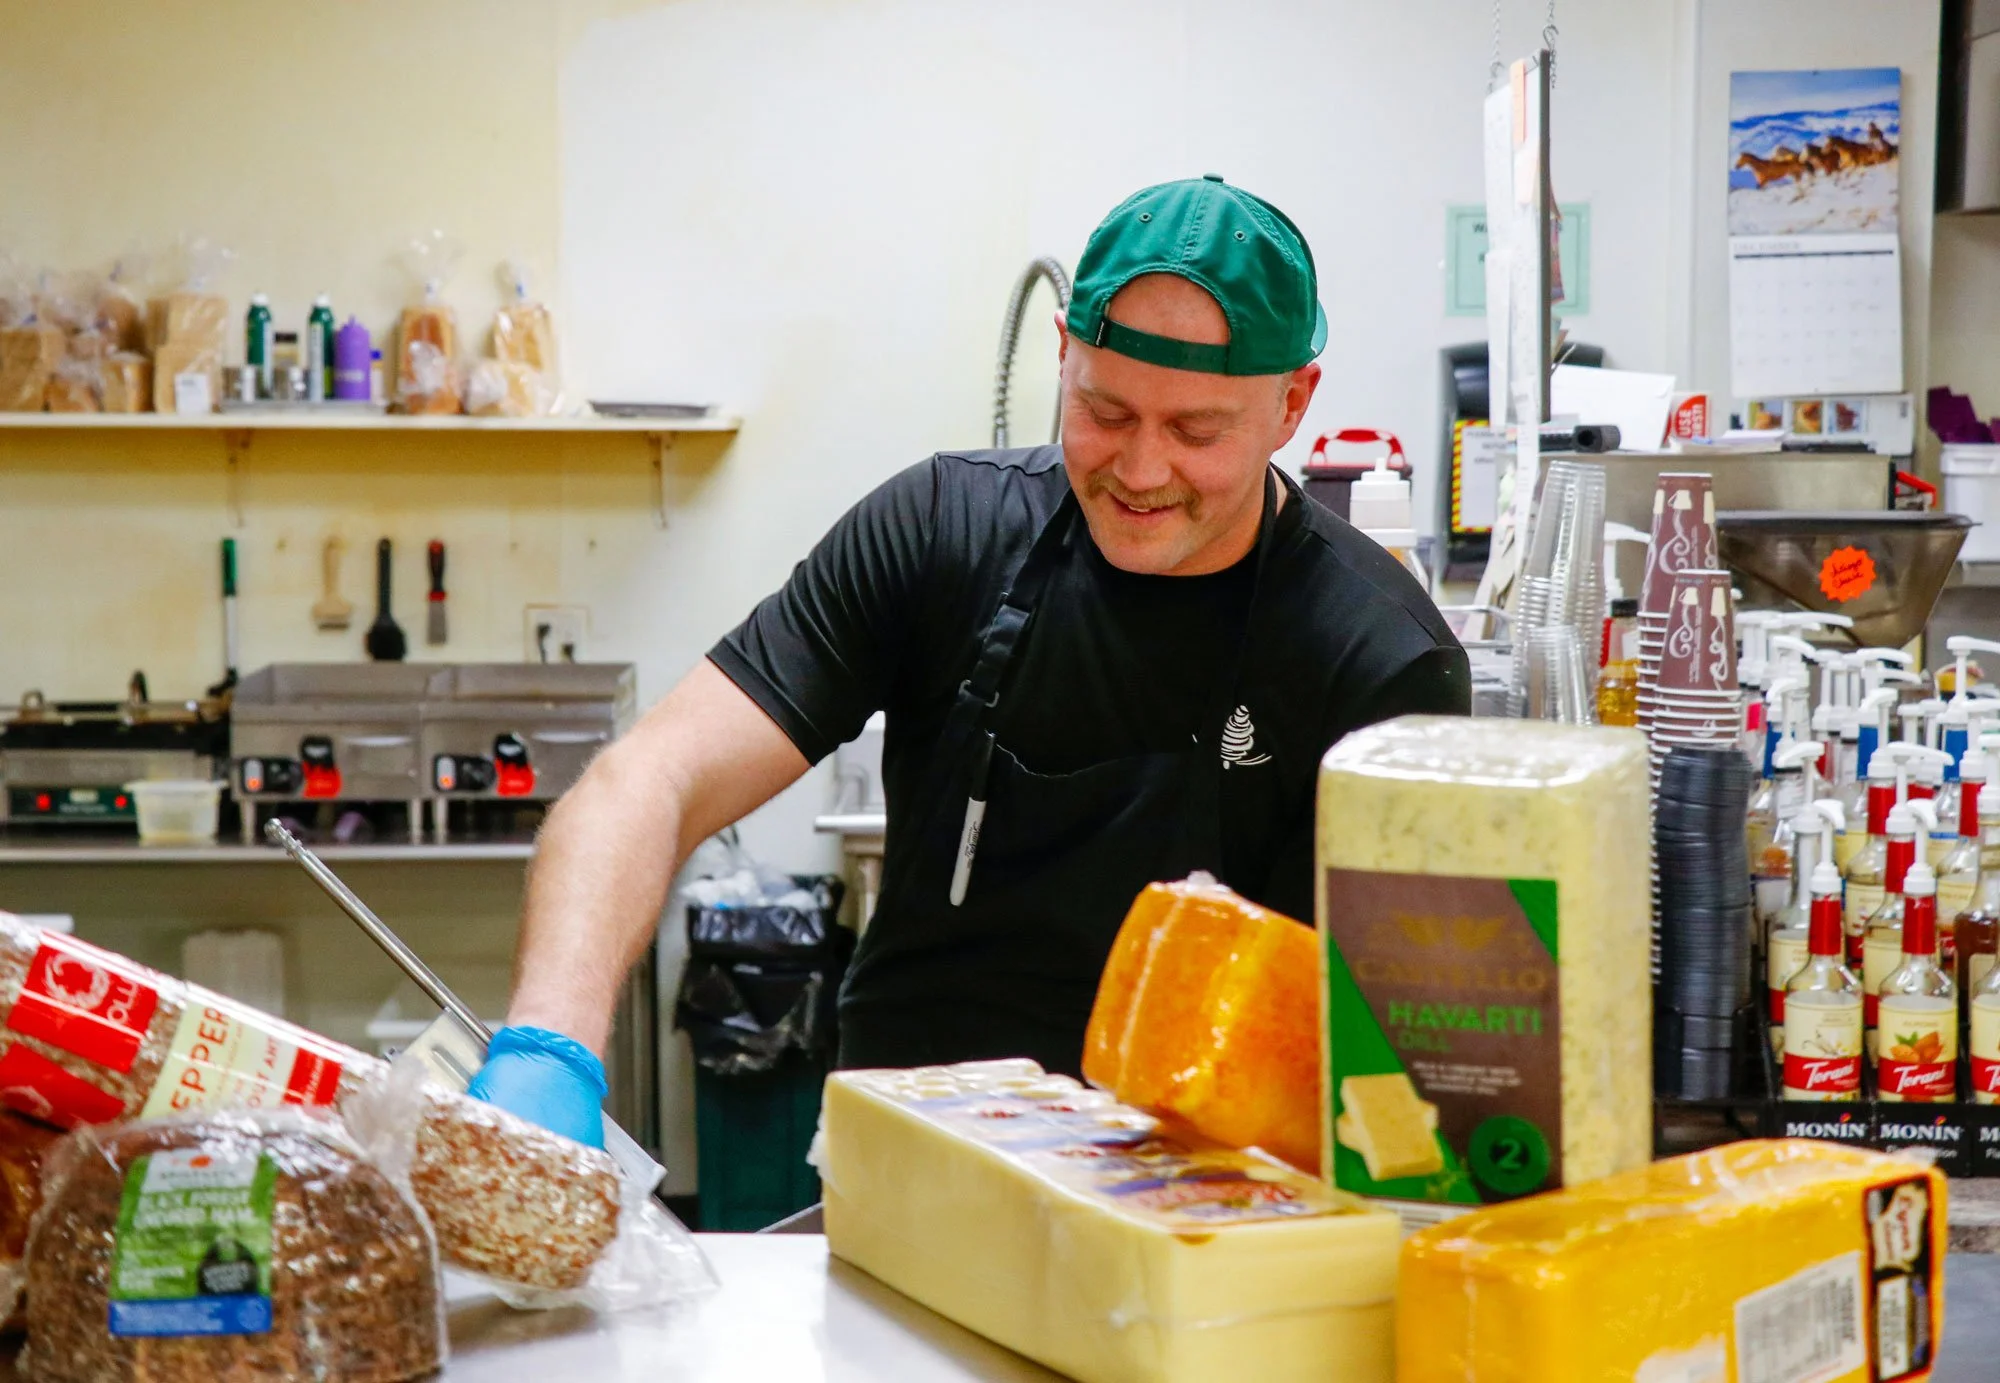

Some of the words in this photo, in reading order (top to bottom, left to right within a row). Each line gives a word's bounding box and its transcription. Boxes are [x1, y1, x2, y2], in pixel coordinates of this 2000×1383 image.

[1388, 1000, 1542, 1035] HAVARTI
[170, 1007, 229, 1112] EPPER
[1802, 1060, 1854, 1089] Torani
[1893, 1064, 1947, 1093] Torani
[1500, 1138, 1521, 1169] 2
